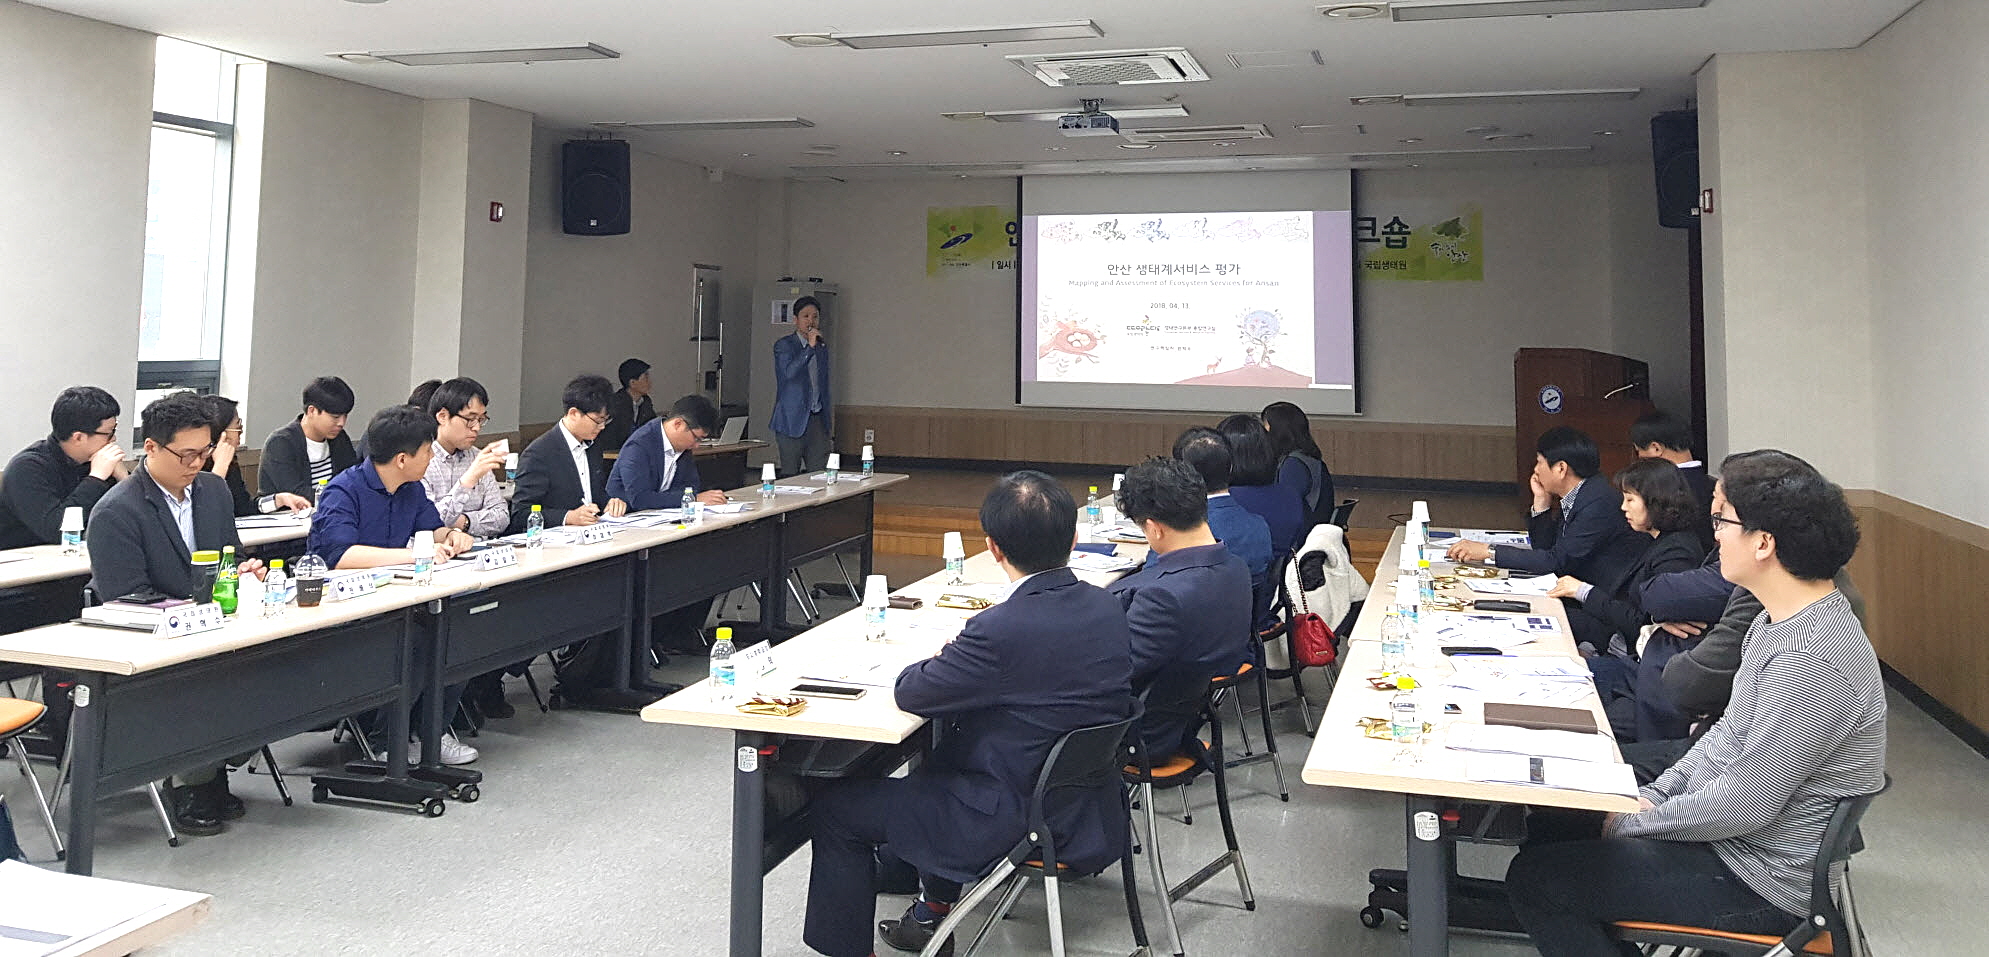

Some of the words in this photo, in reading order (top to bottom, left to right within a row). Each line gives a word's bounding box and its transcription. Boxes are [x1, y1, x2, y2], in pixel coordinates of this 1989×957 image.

[1107, 264, 1132, 276] 안산
[1136, 264, 1211, 276] 생태계서비스
[1215, 264, 1241, 276] 평가
[1364, 260, 1407, 271] 국립생태원
[1068, 279, 1099, 288] Mapping
[1169, 279, 1208, 288] Ecosystem
[1209, 279, 1241, 287] Services
[1150, 302, 1168, 310] 2018.
[1169, 302, 1180, 310] 04.
